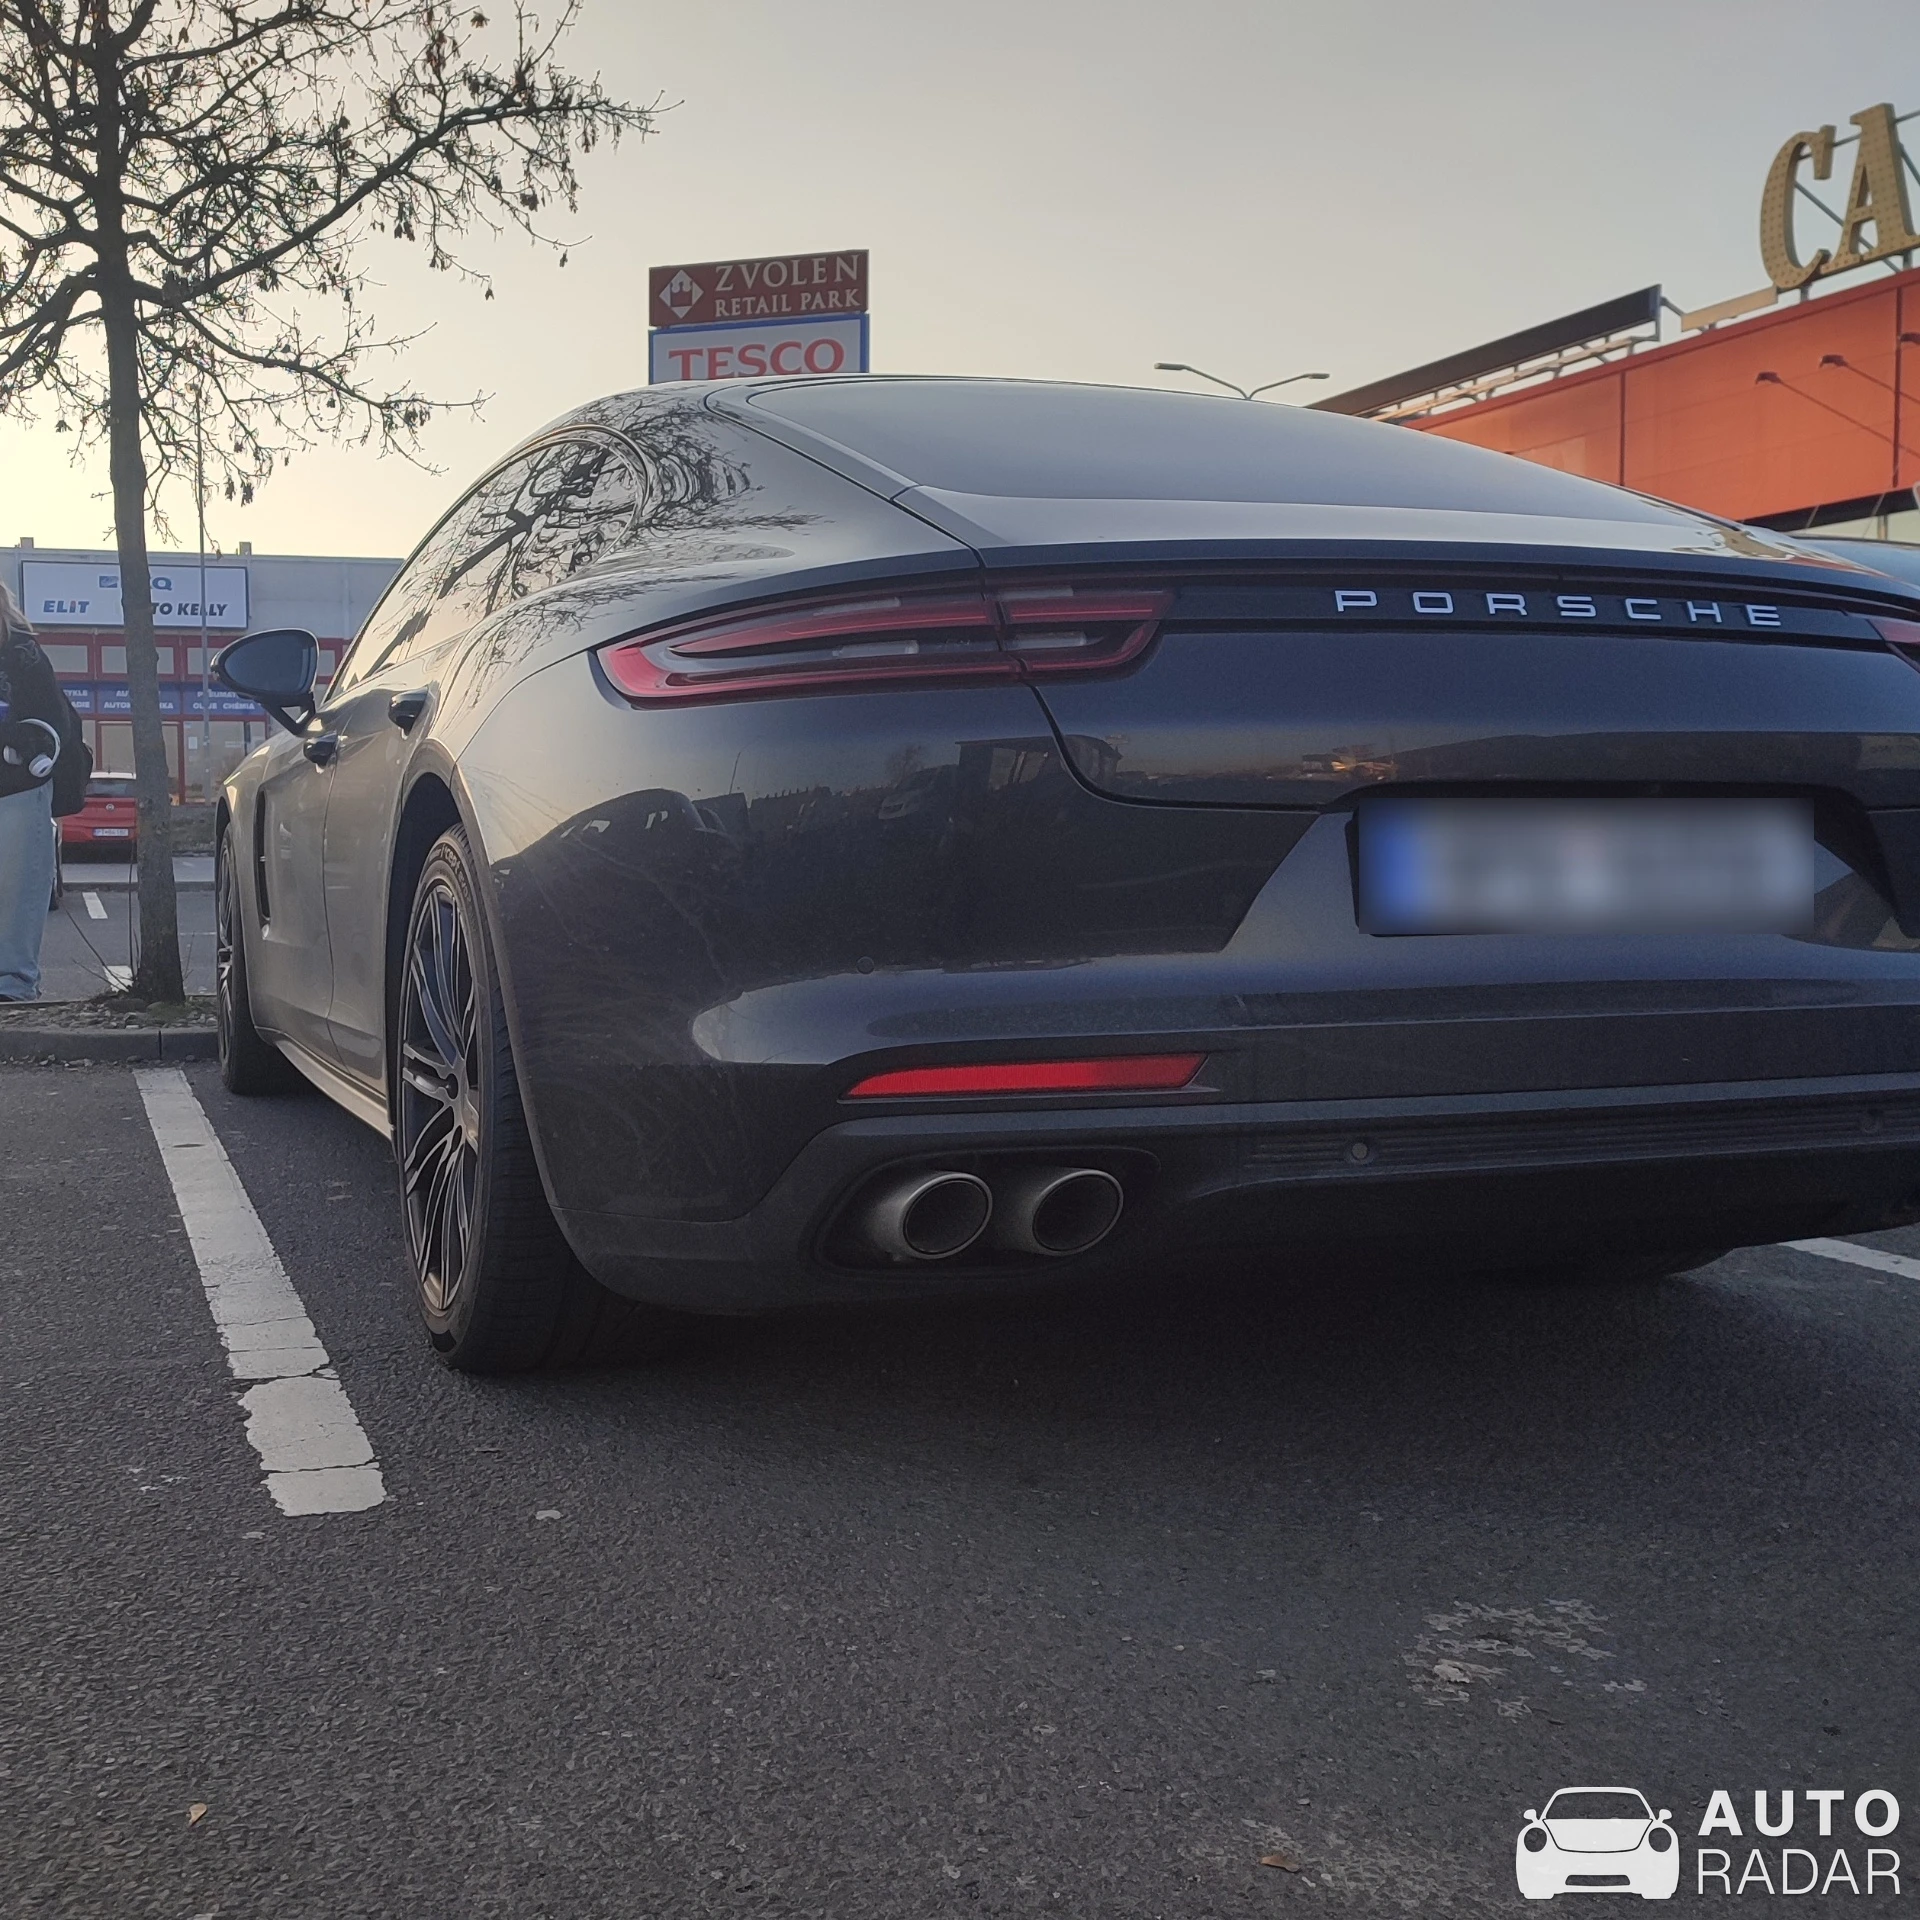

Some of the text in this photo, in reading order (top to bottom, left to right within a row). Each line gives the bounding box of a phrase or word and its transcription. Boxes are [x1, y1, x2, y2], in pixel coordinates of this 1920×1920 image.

[1760, 103, 1920, 291] CA
[714, 254, 860, 292] ZVOLEN
[714, 289, 861, 318] RETAIL PARK
[668, 338, 845, 381] TESCO
[43, 600, 90, 613] ELIT
[1334, 589, 1782, 626] PORSCHE
